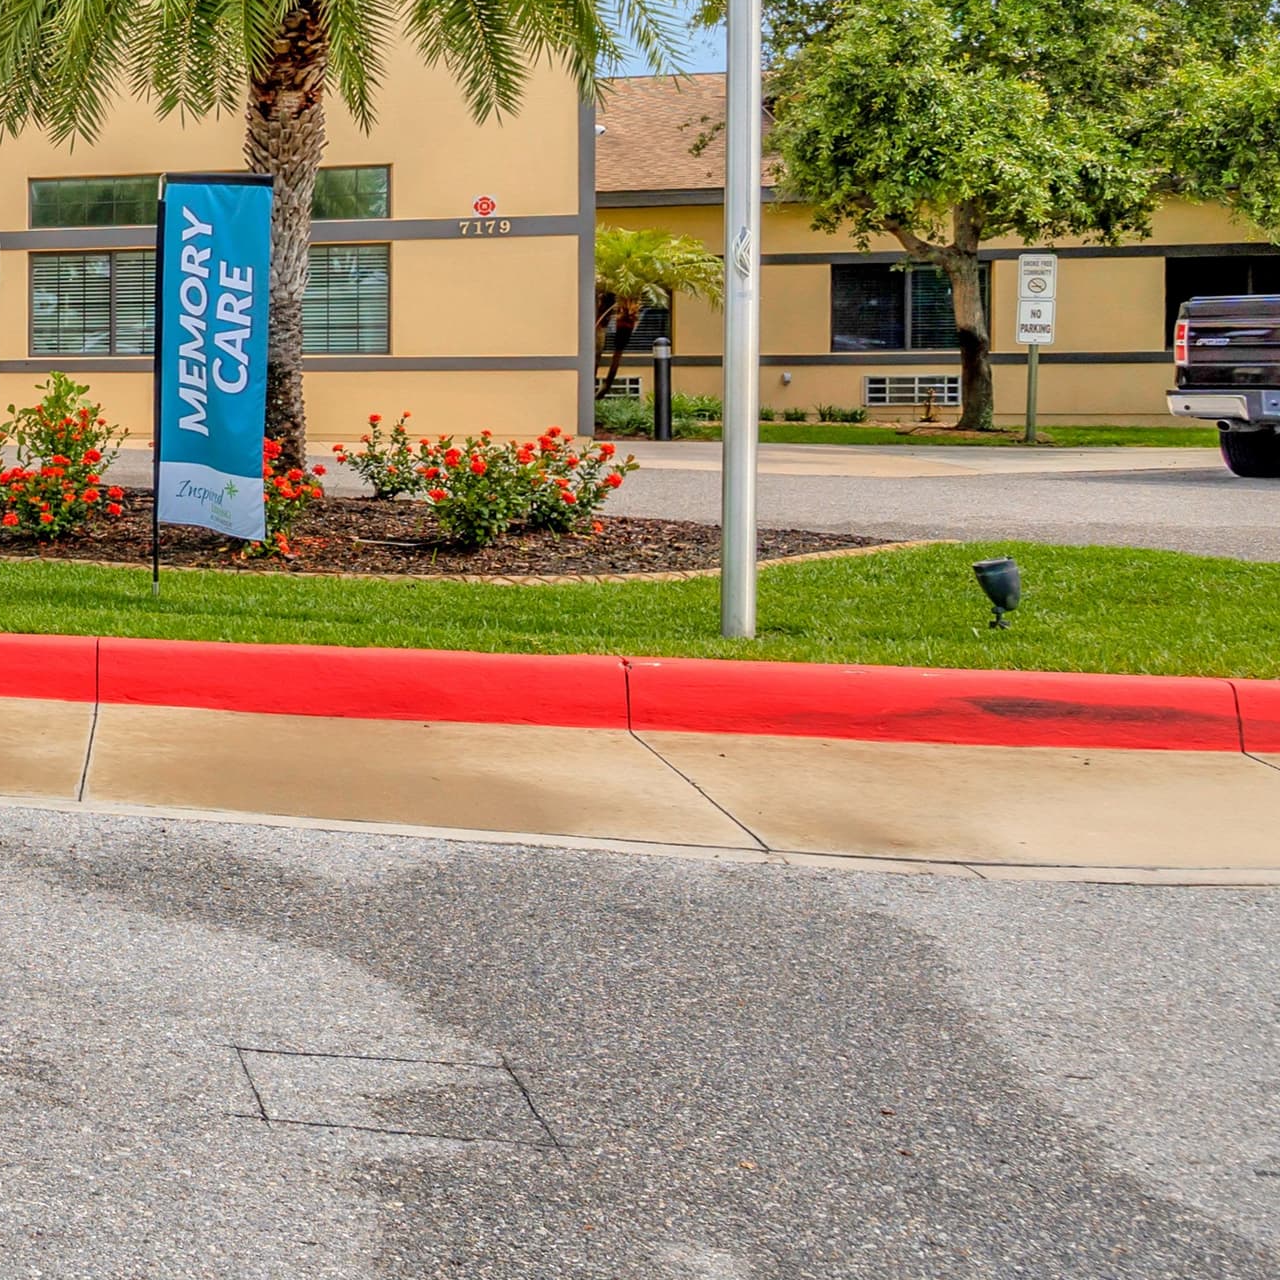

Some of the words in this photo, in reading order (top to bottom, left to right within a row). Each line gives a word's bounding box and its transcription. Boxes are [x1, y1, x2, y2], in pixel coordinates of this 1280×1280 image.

[459, 220, 511, 235] 7179
[178, 205, 213, 437] MEMORY
[1031, 309, 1042, 319] NO
[212, 260, 253, 394] CARE
[1020, 323, 1051, 333] PARKING
